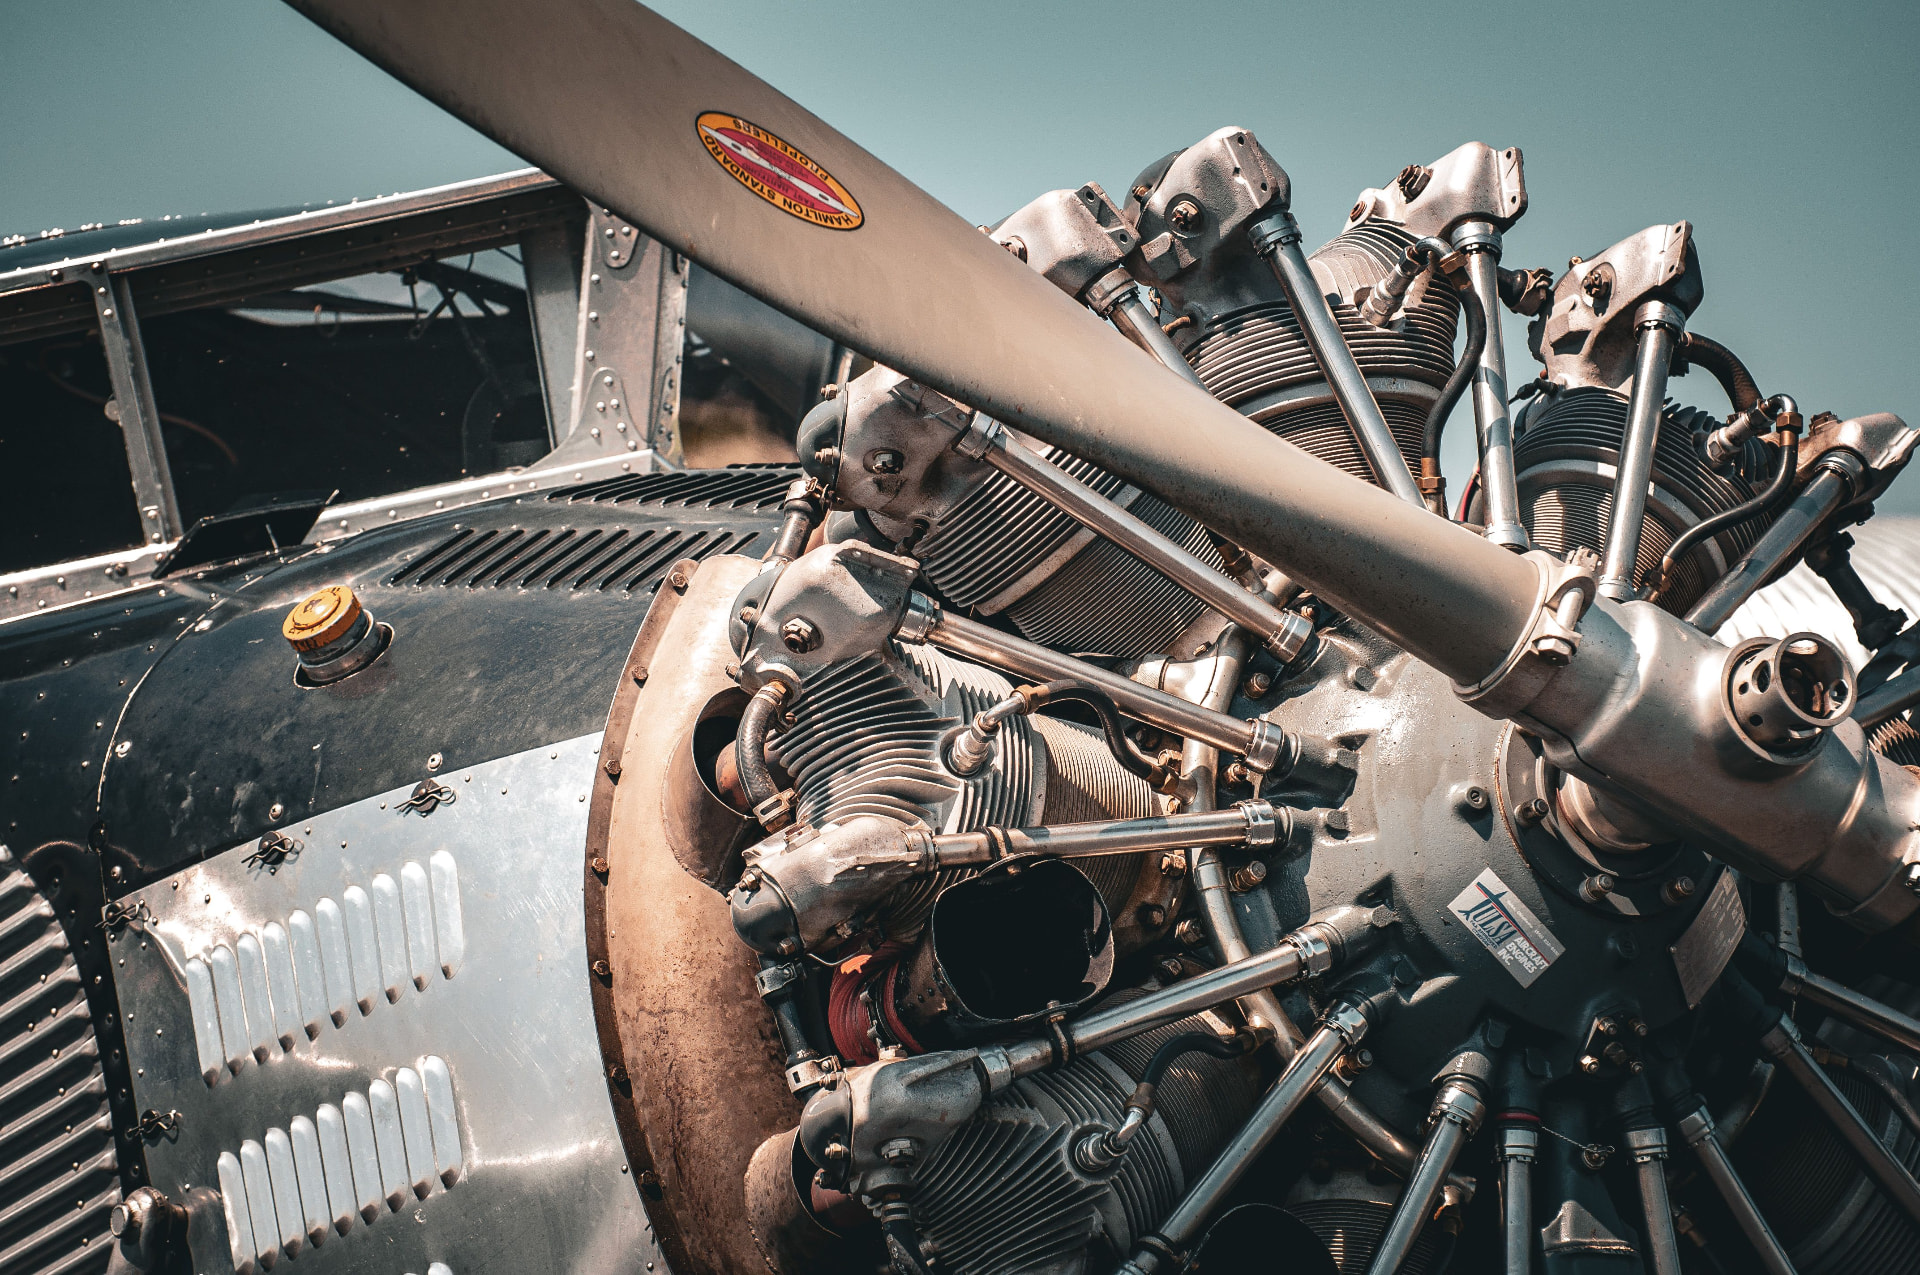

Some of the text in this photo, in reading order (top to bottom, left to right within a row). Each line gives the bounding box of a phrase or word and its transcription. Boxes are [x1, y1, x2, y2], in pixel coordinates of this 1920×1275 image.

[733, 119, 828, 181] PROPELLERS
[704, 135, 776, 200] STANDARD
[782, 198, 854, 226] HAMILTON
[1458, 885, 1521, 946] TULSA
[1497, 948, 1514, 966] INC.
[1506, 942, 1537, 974] ENGINES
[1514, 936, 1550, 970] AIRCRAFT
